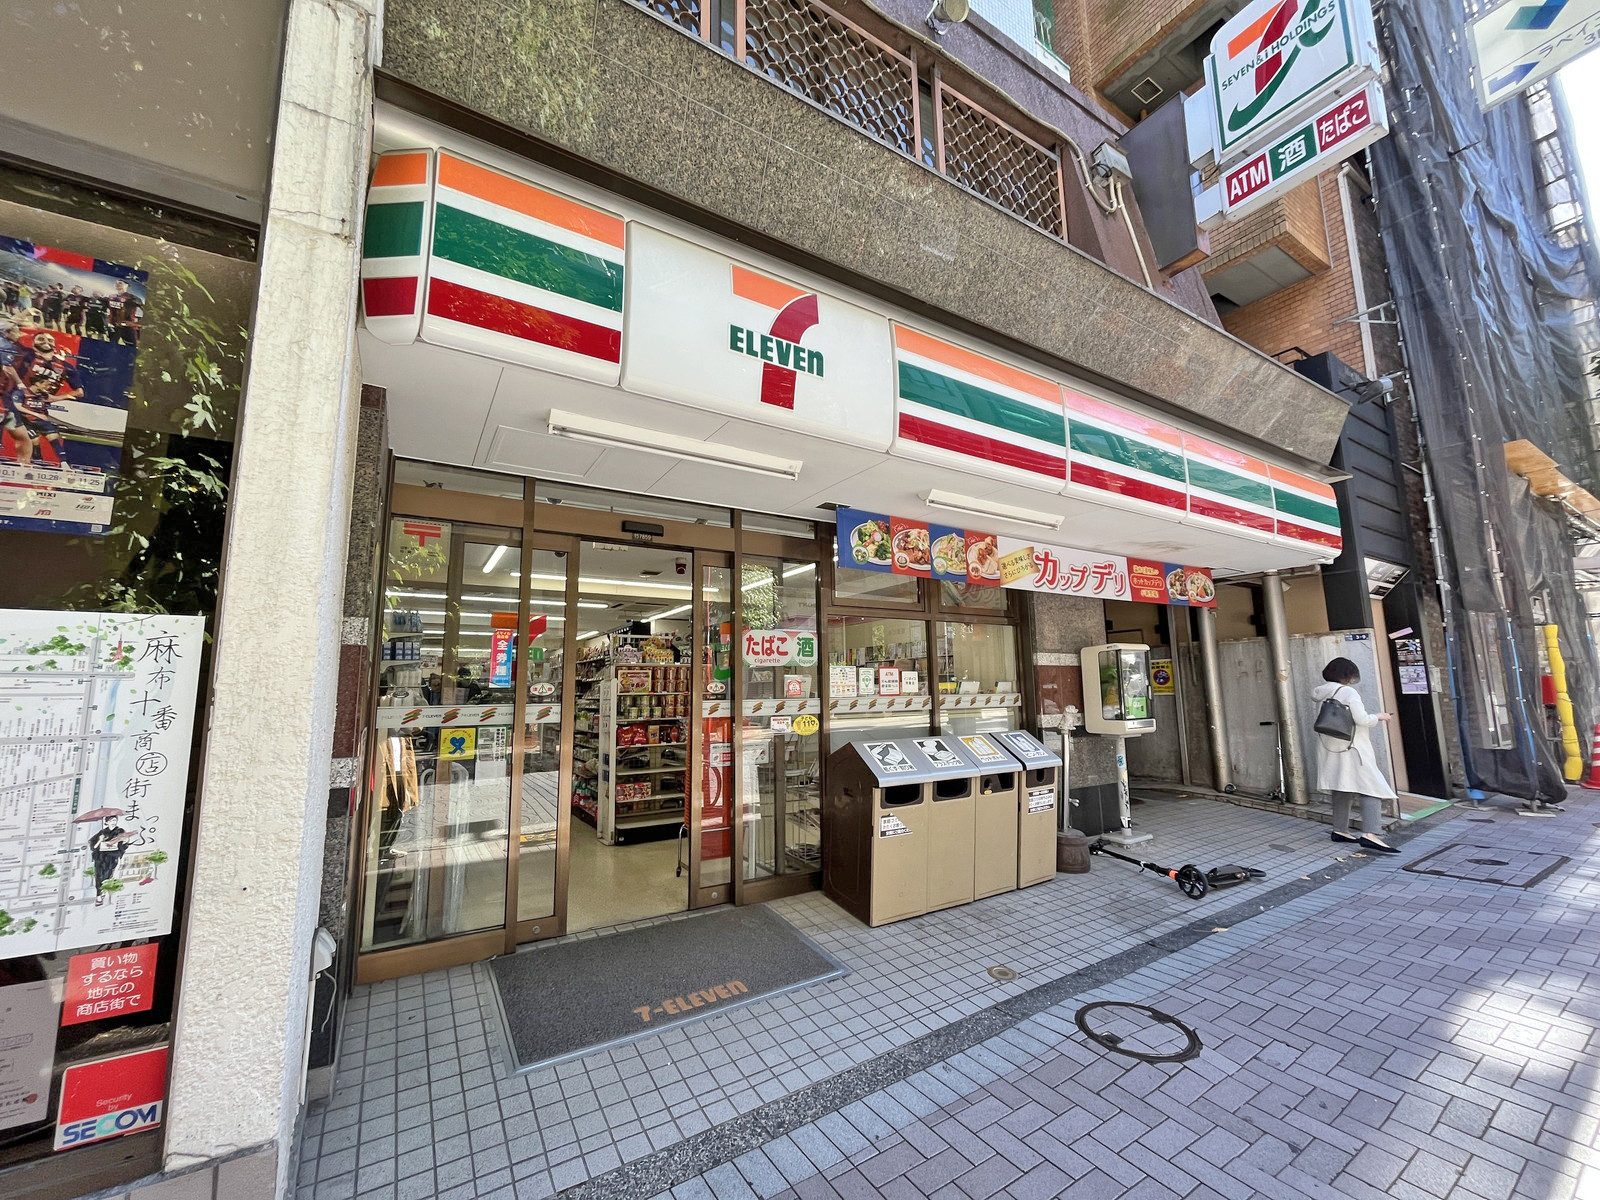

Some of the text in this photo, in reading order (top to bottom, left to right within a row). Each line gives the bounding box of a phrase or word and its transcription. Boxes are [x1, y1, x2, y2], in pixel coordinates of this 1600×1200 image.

[1272, 1, 1336, 54] HOLDINGS
[1319, 101, 1369, 146] たばこ
[1278, 134, 1306, 172] 酒
[1230, 167, 1268, 200] ATM
[1004, 562, 1034, 579] さらにひろがる
[1033, 549, 1127, 597] カップデリ
[745, 634, 814, 658] たばこ 酒
[90, 952, 138, 971] 買い物
[82, 965, 144, 987] するなら
[87, 982, 135, 1000] 地元の
[76, 993, 141, 1017] 商店街で
[96, 1093, 133, 1107] Security
[108, 1104, 119, 1112] by
[63, 1104, 157, 1145] SECOM
